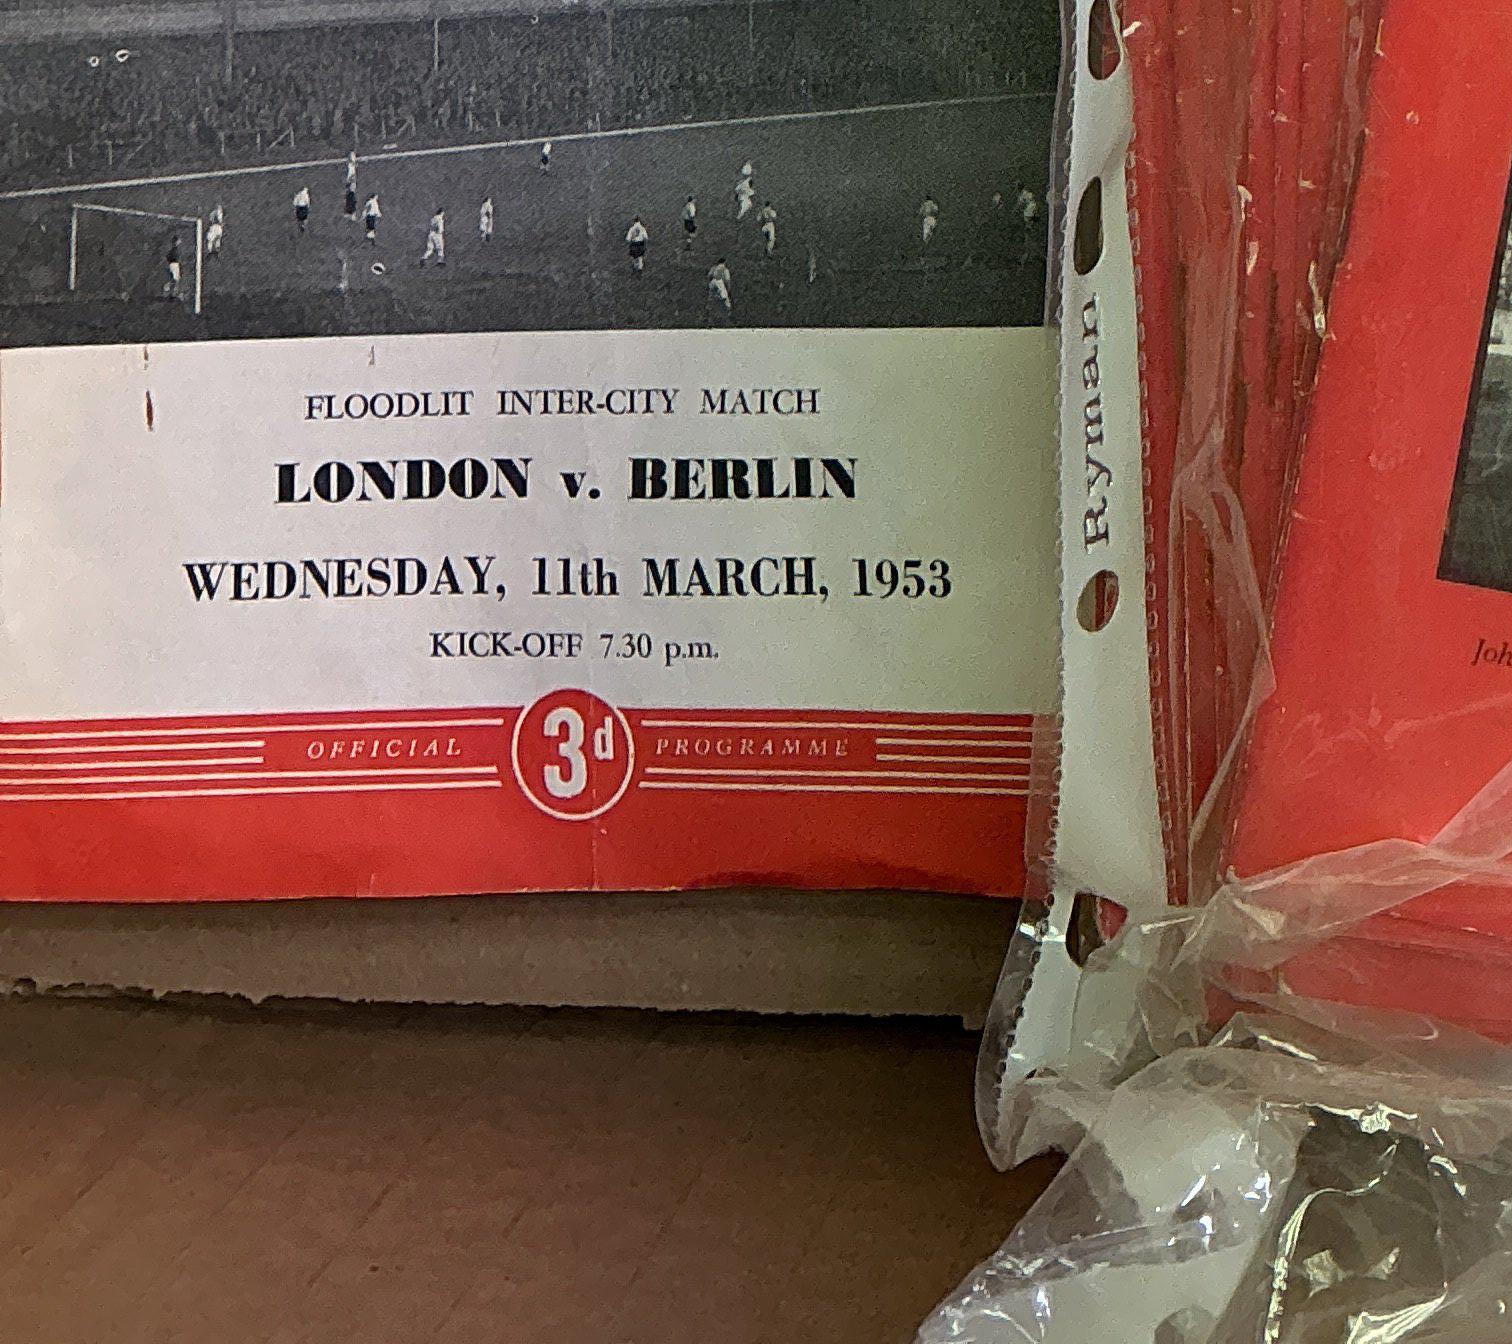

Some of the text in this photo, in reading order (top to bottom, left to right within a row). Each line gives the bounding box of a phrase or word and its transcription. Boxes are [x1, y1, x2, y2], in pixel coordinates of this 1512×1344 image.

[304, 388, 821, 420] FLOODLIT INTER-CITY MATCH
[1082, 291, 1112, 554] Ryman
[273, 456, 858, 504] LONDON v. BERLIN
[182, 555, 954, 604] WEDNESDAY, 11th MARCH, 1953
[428, 632, 720, 666] KICK-OFF 7.30 p.m.
[306, 706, 851, 800] OFFICIAL 3d PROGRAMME
